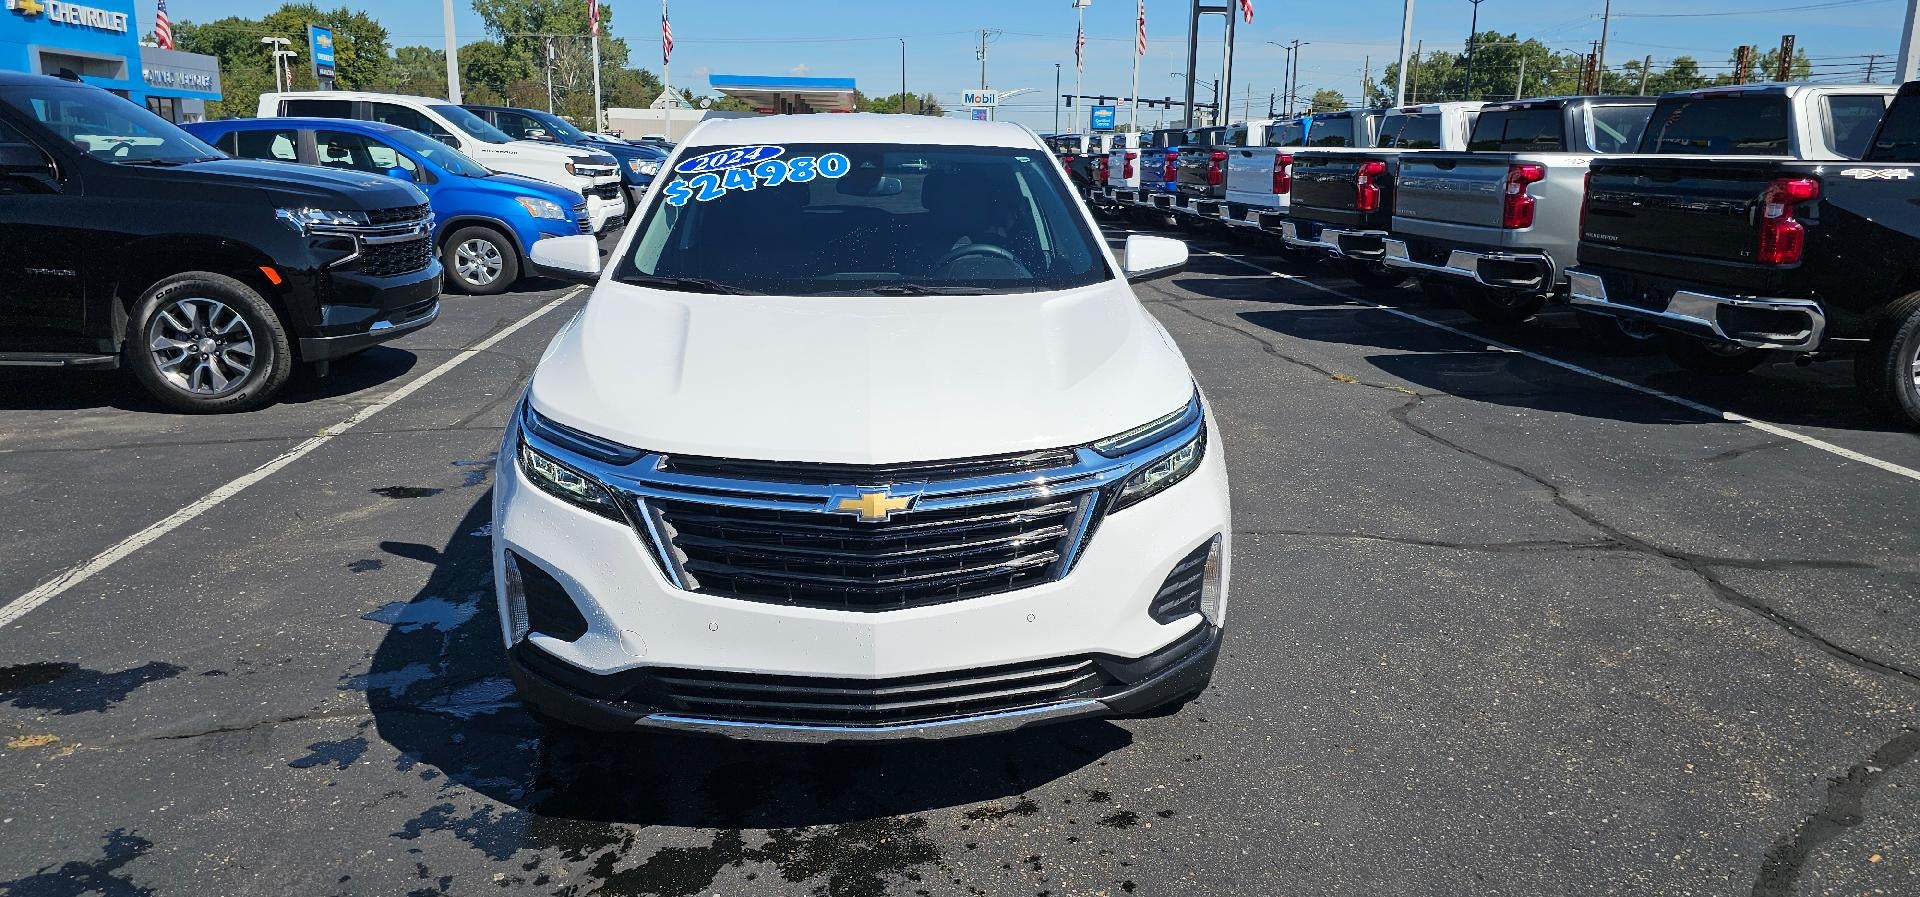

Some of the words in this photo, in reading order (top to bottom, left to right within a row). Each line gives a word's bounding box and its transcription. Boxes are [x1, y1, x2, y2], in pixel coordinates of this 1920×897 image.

[49, 1, 128, 32] CHEVROLET
[964, 93, 996, 104] Mobil
[691, 146, 765, 168] 2024
[663, 152, 851, 207] $24980
